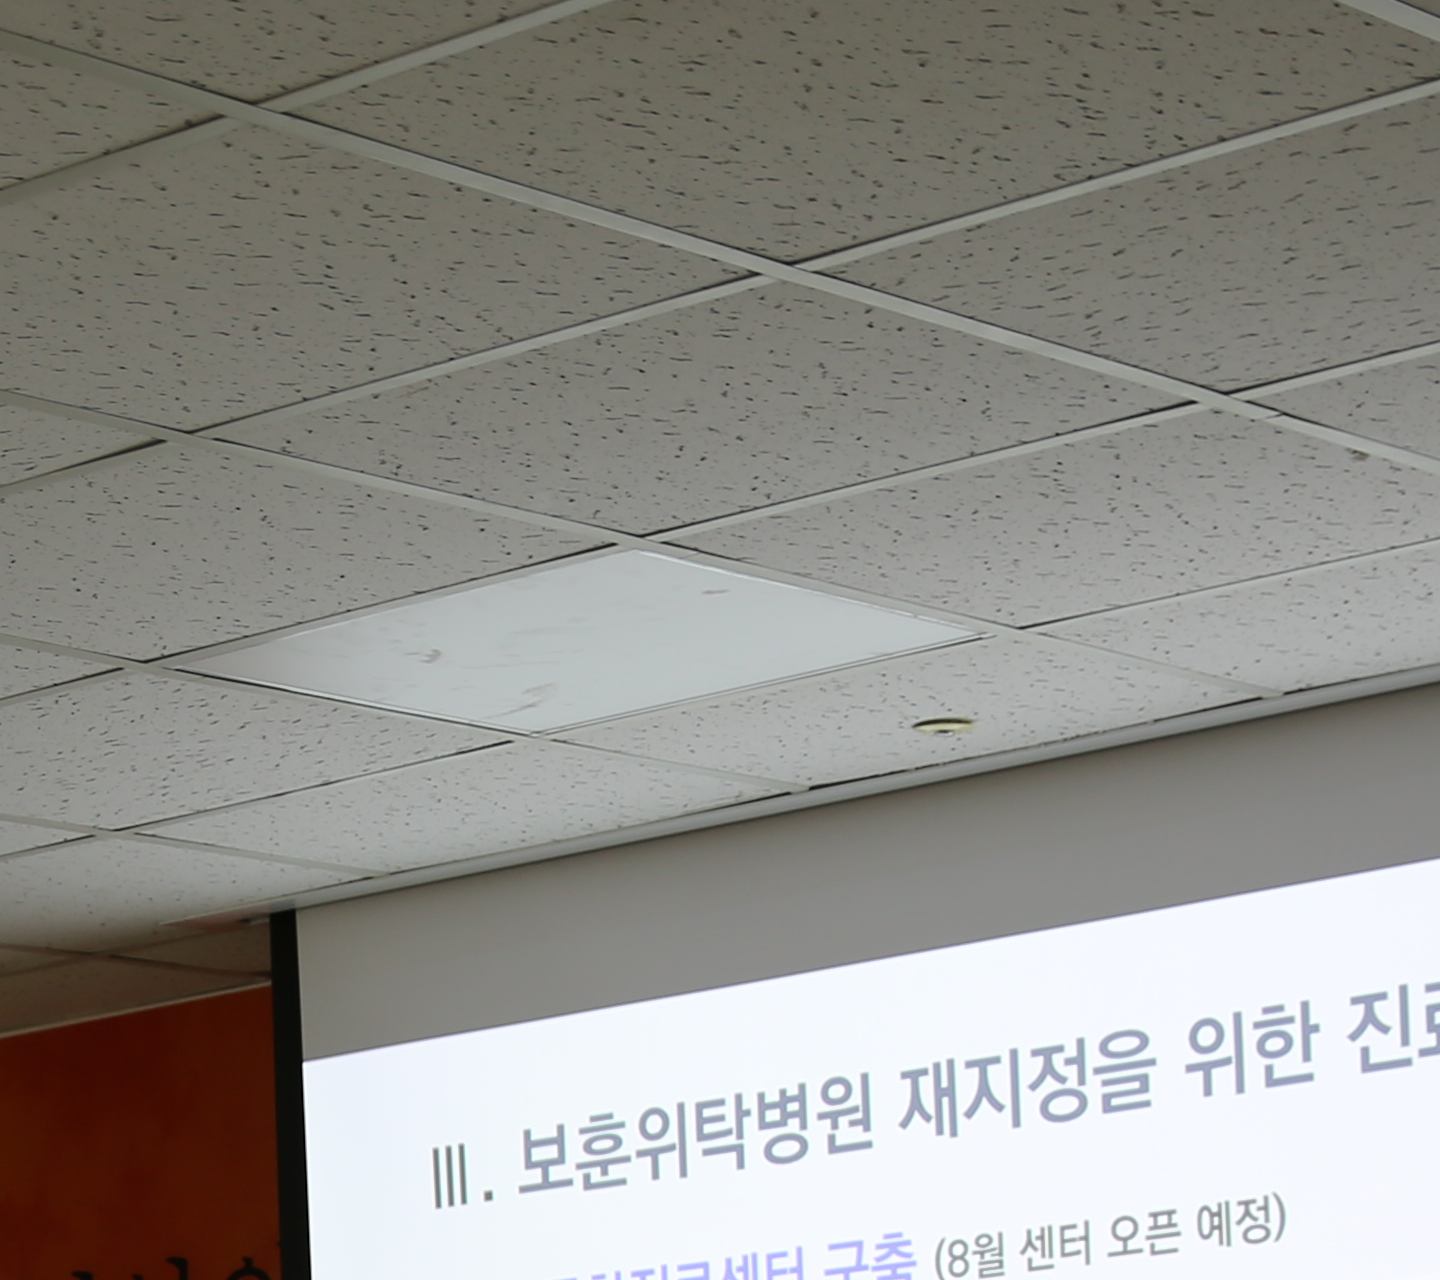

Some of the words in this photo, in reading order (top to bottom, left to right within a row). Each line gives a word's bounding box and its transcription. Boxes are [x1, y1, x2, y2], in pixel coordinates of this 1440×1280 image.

[519, 1072, 873, 1194] 보훈위탁병원
[899, 1029, 1156, 1138] 재지정을
[1185, 1000, 1320, 1097] 위한
[1020, 1220, 1090, 1271] 센터
[1108, 1209, 1181, 1257] 오픈
[1197, 1193, 1285, 1247] 예정)
